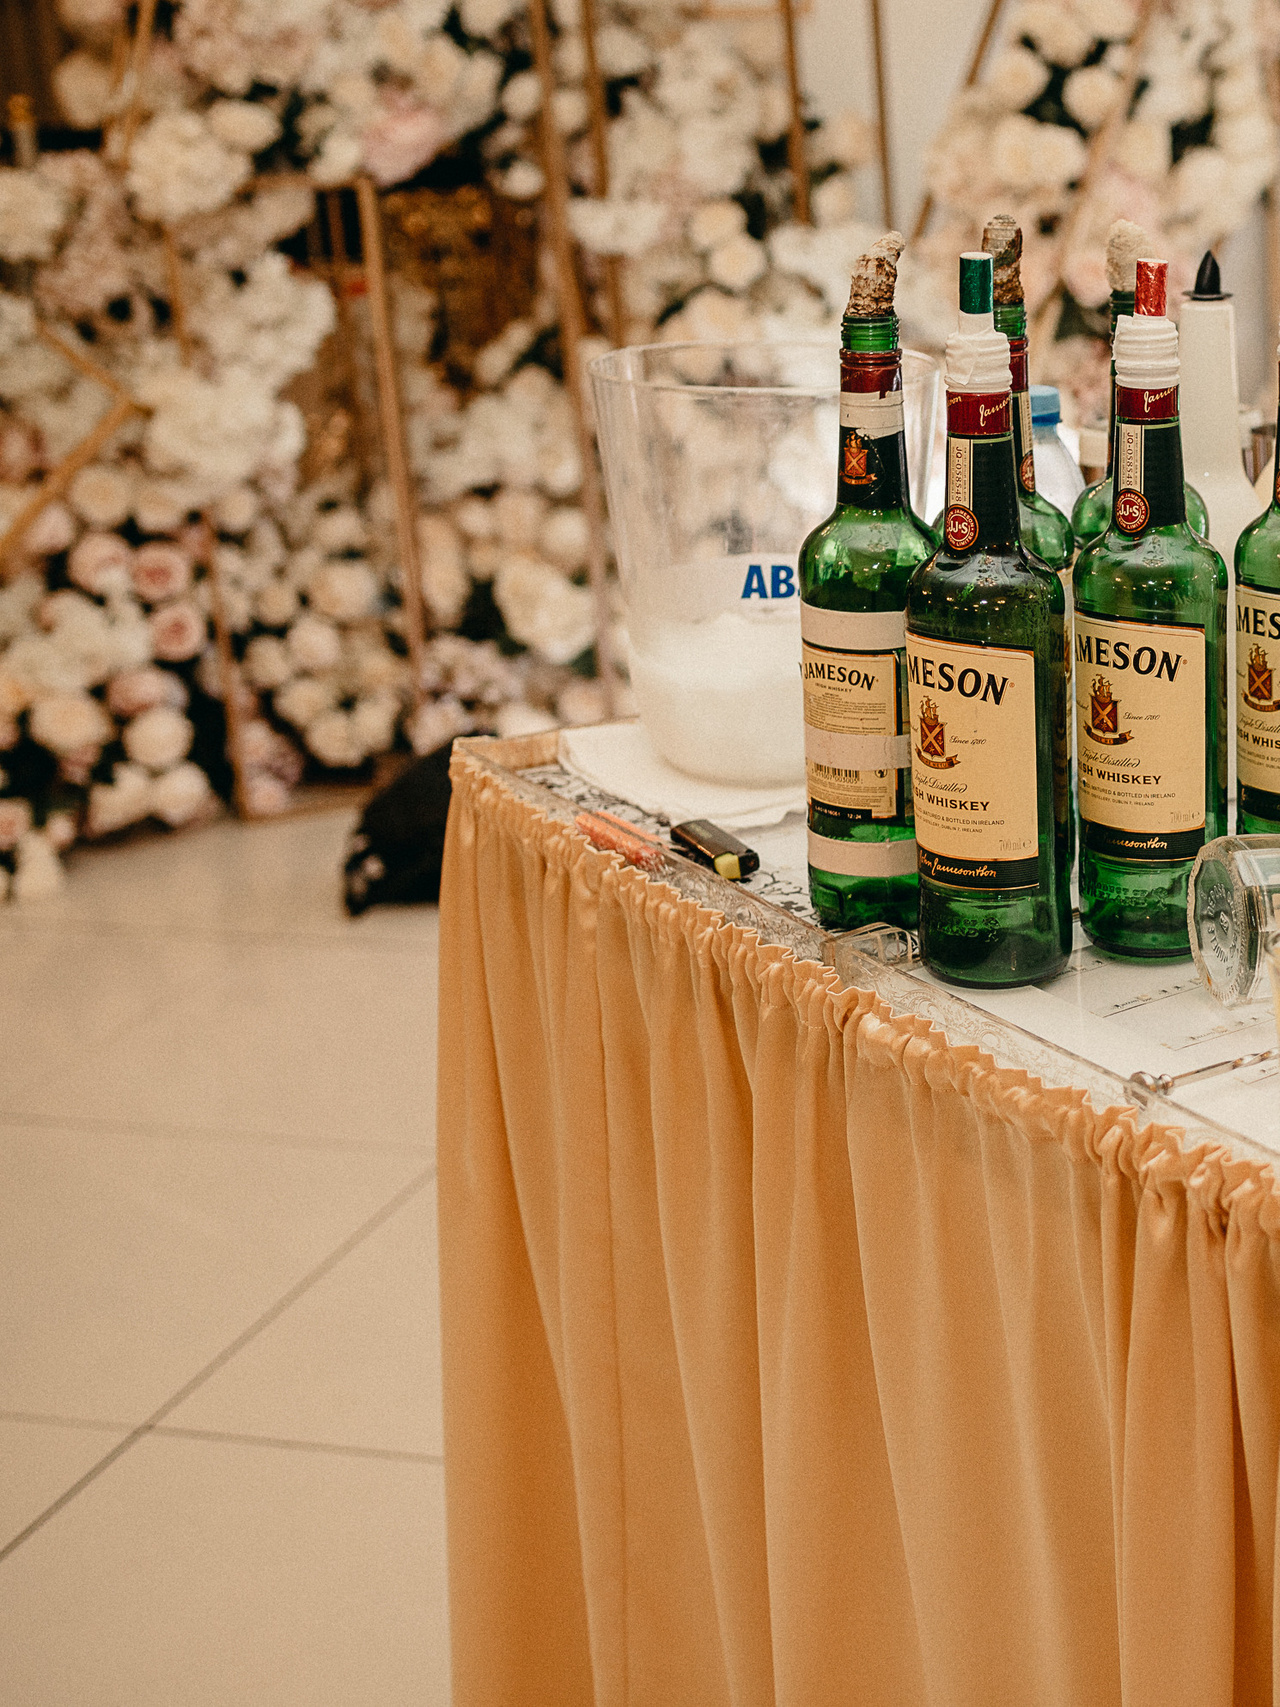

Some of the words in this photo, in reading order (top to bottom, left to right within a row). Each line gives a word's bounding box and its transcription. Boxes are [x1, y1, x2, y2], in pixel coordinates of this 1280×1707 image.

[1126, 431, 1134, 487] JQ-058548
[955, 446, 963, 503] JQ-058548
[741, 565, 800, 599] AB
[805, 662, 875, 691] JAMESON
[827, 685, 852, 693] WHISKEY
[949, 735, 970, 745] Since
[1099, 752, 1141, 768] Distilled
[928, 776, 968, 794] Distilled
[1096, 768, 1162, 785] WHISKEY
[1091, 785, 1112, 796] MATURED
[1117, 791, 1143, 799] BOTTLED
[926, 793, 990, 811] WHISKEY
[941, 823, 957, 831] DUBLIN
[946, 815, 971, 826] BOTTLED
